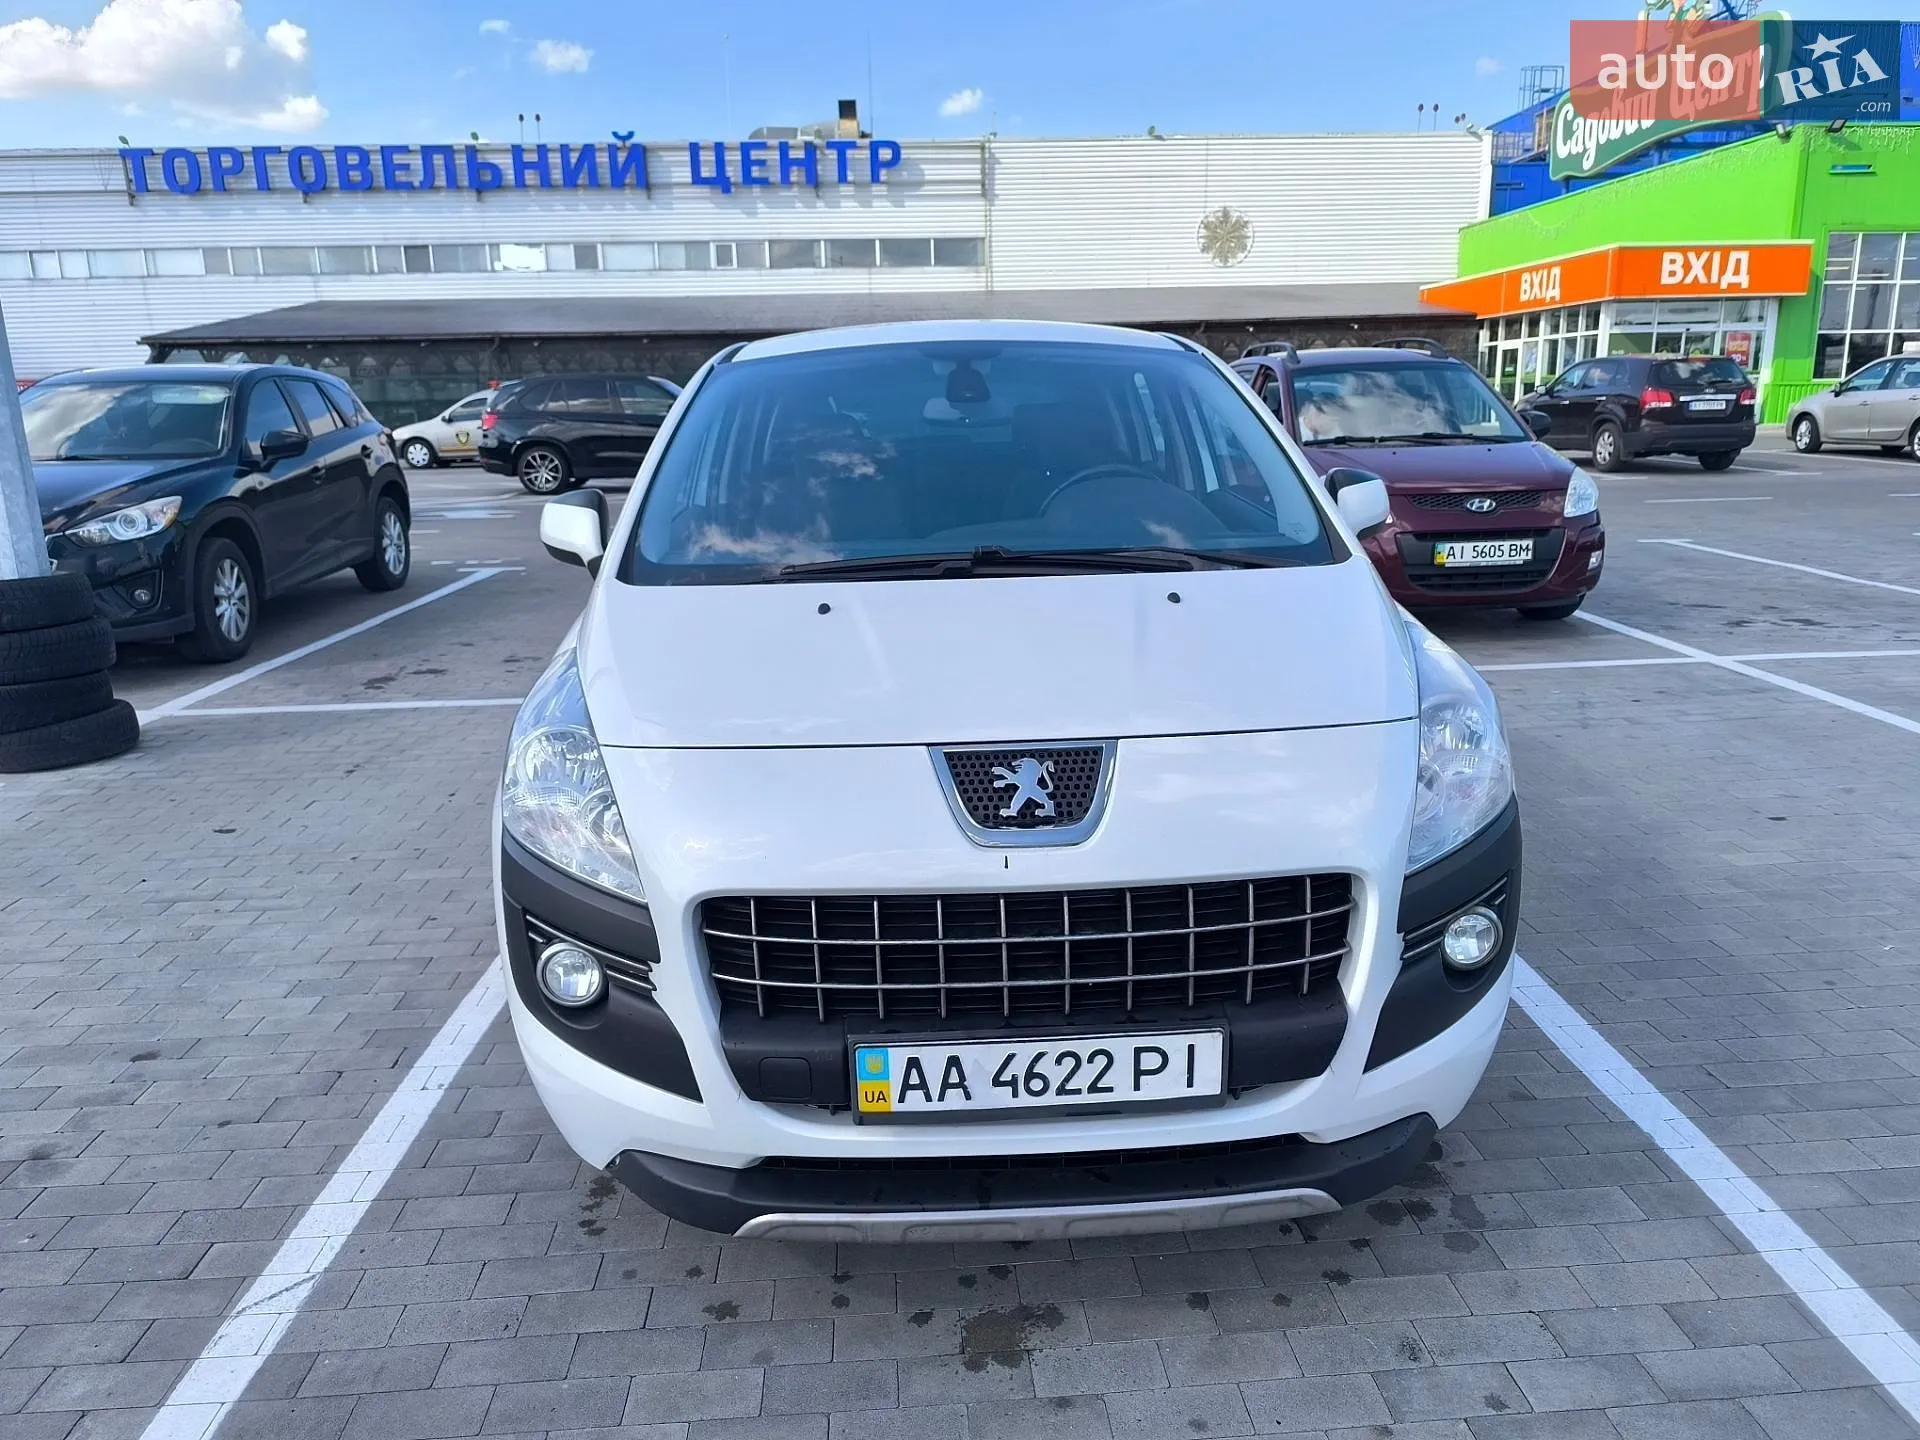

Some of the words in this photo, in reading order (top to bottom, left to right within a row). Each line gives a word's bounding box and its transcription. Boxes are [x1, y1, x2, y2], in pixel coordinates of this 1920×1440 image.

[119, 130, 648, 196] ТОРГОВЕЛЬНИЙ
[689, 139, 902, 194] ЦЕНТР
[1519, 265, 1562, 303] ВХІД
[1659, 250, 1750, 290] ВХІД
[1471, 544, 1505, 559] 5605
[1508, 543, 1531, 558] BM
[897, 1054, 973, 1104] AA
[990, 1048, 1115, 1099] 4622
[1132, 1043, 1196, 1092] PI
[864, 1090, 888, 1104] UA
